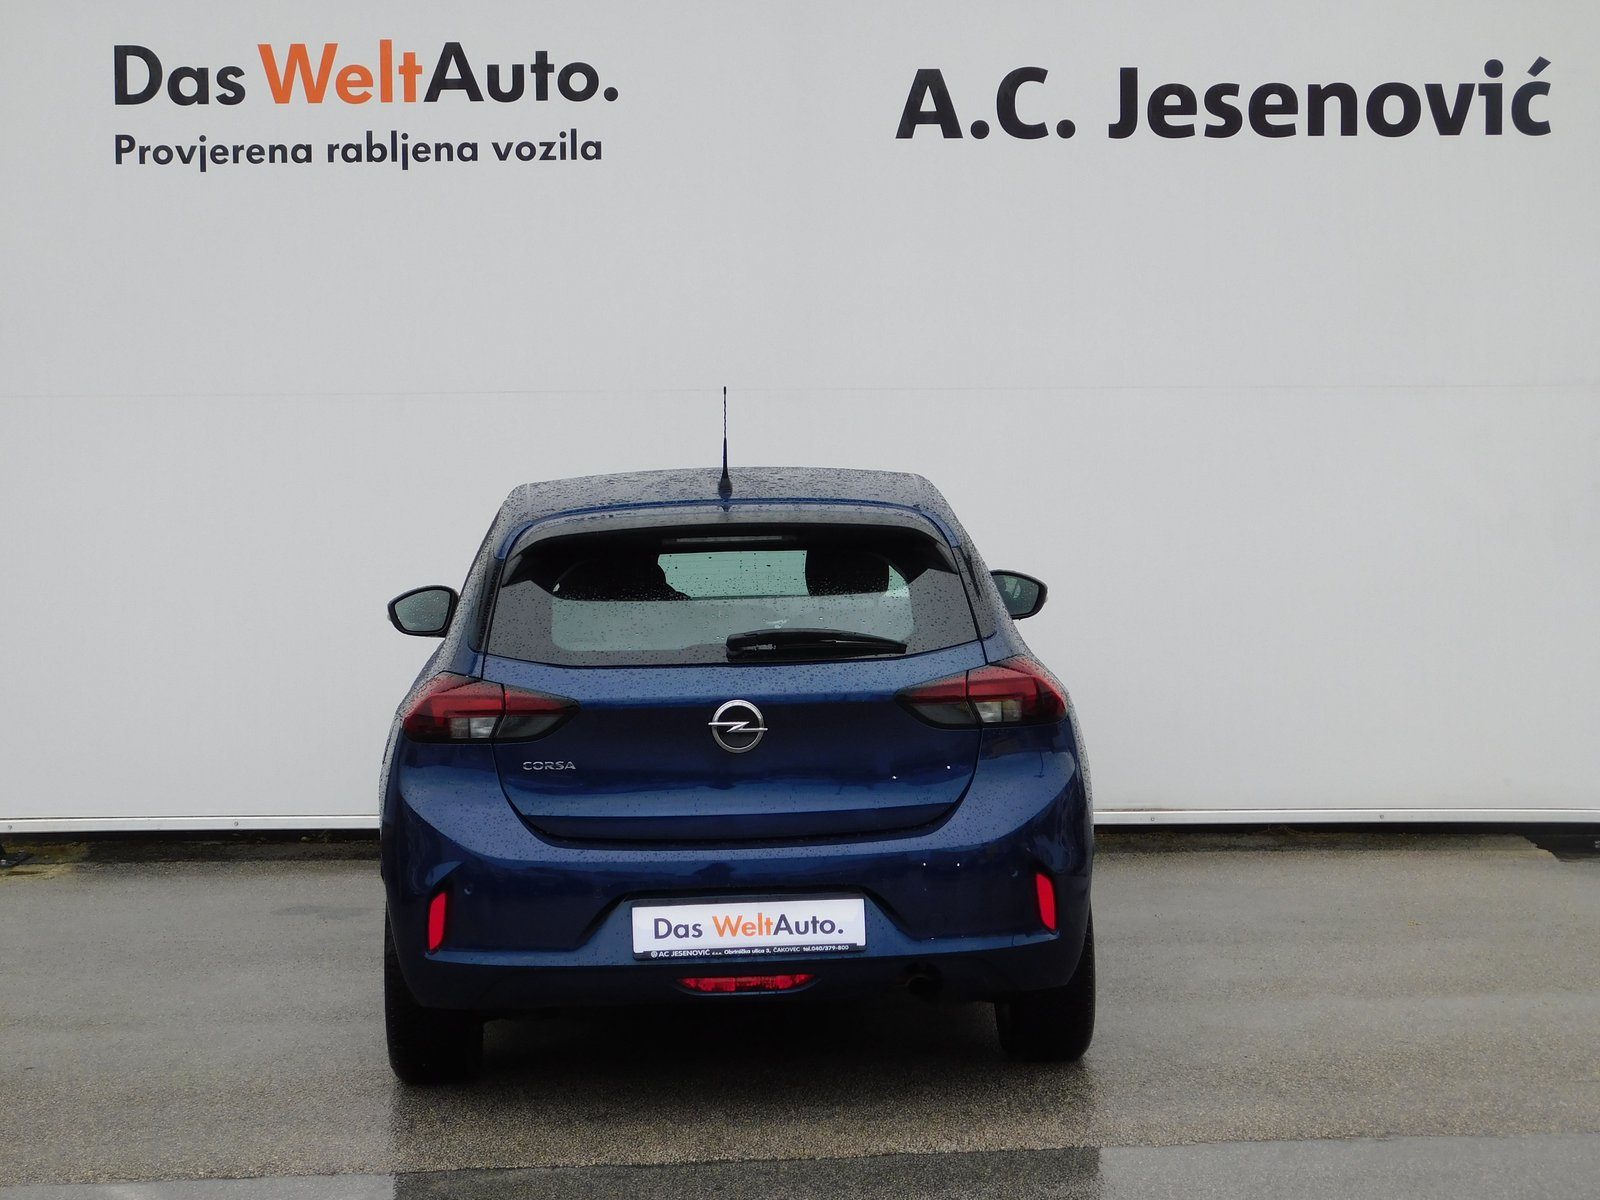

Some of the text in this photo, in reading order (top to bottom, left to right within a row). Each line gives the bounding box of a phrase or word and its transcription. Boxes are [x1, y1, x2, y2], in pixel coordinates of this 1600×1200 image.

[114, 39, 619, 107] Das WeltAuto.
[896, 56, 1552, 140] A.C. Jesenović
[115, 128, 602, 173] Provjerena rabljena vozila
[522, 760, 577, 771] CORSA
[653, 912, 844, 940] Das WeltAuto.
[671, 949, 711, 957] JESENOVIĆ
